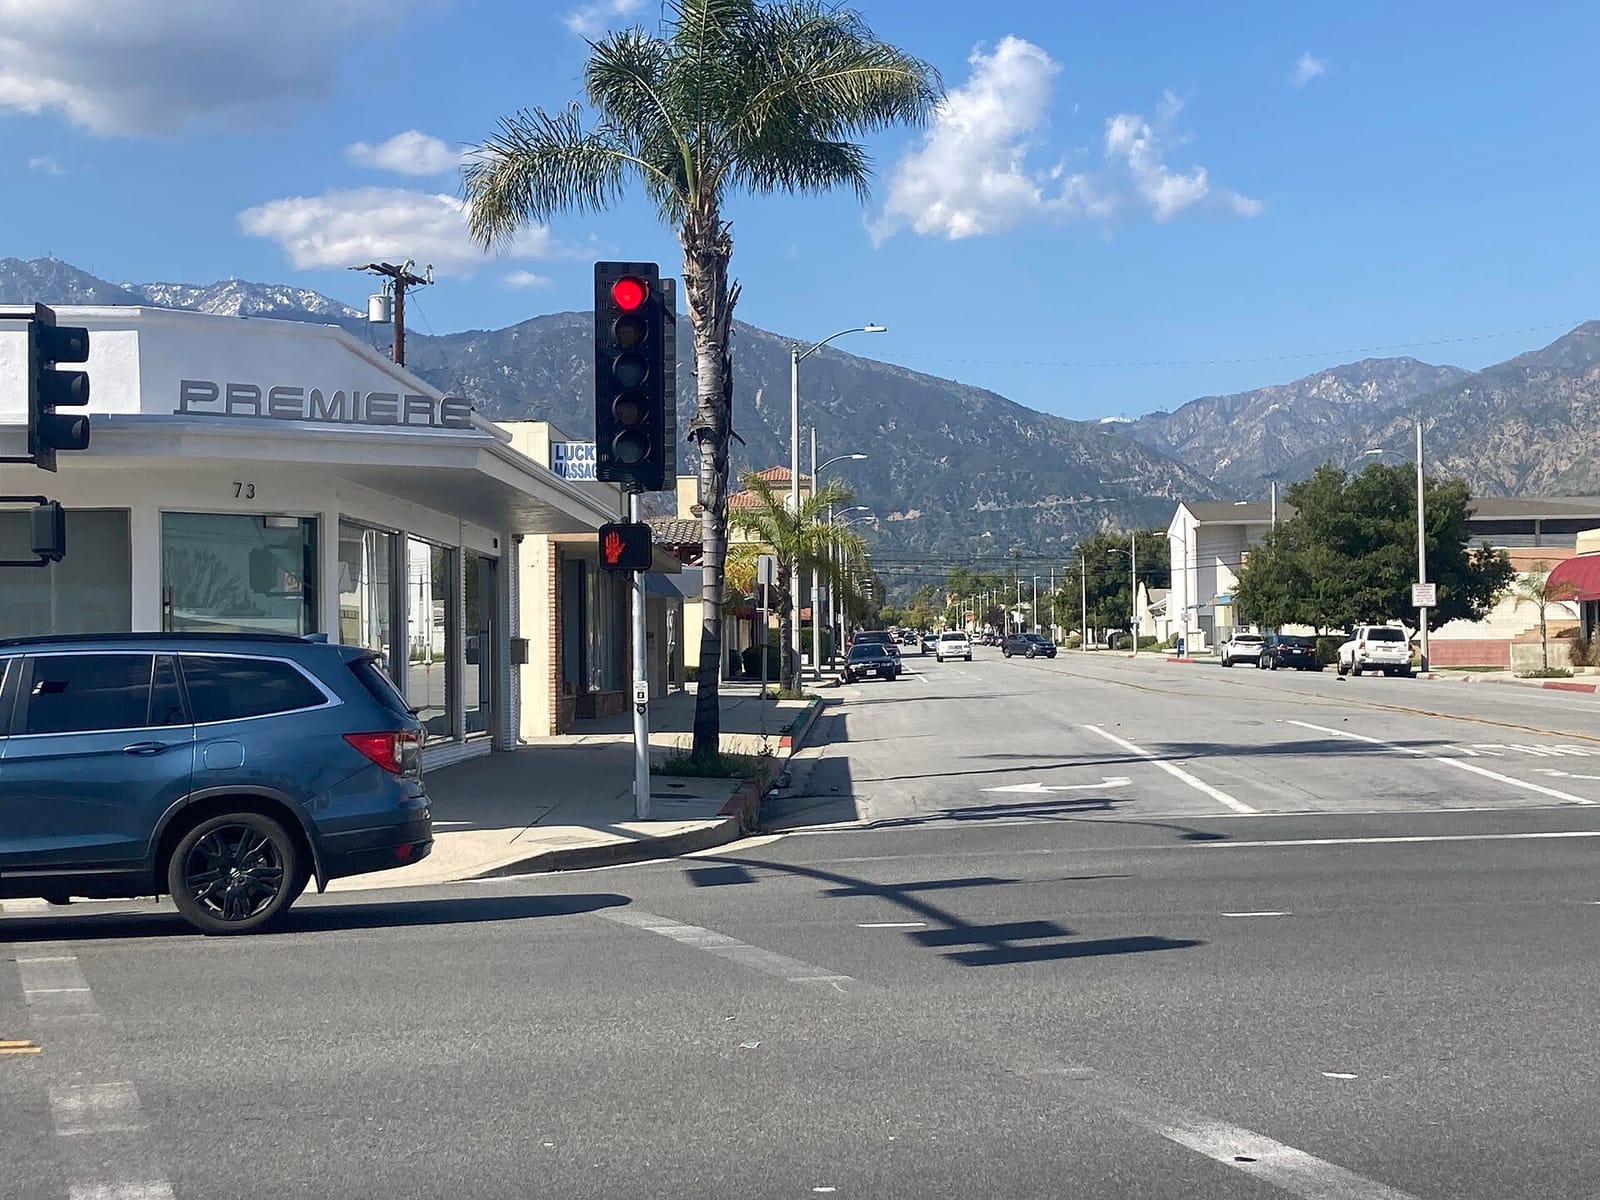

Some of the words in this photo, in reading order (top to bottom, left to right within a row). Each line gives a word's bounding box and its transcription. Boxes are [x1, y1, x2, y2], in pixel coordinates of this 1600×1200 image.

[180, 379, 473, 428] PREMIERE
[555, 445, 597, 461] LUCK
[554, 462, 597, 479] MASSAG
[233, 482, 255, 499] 73
